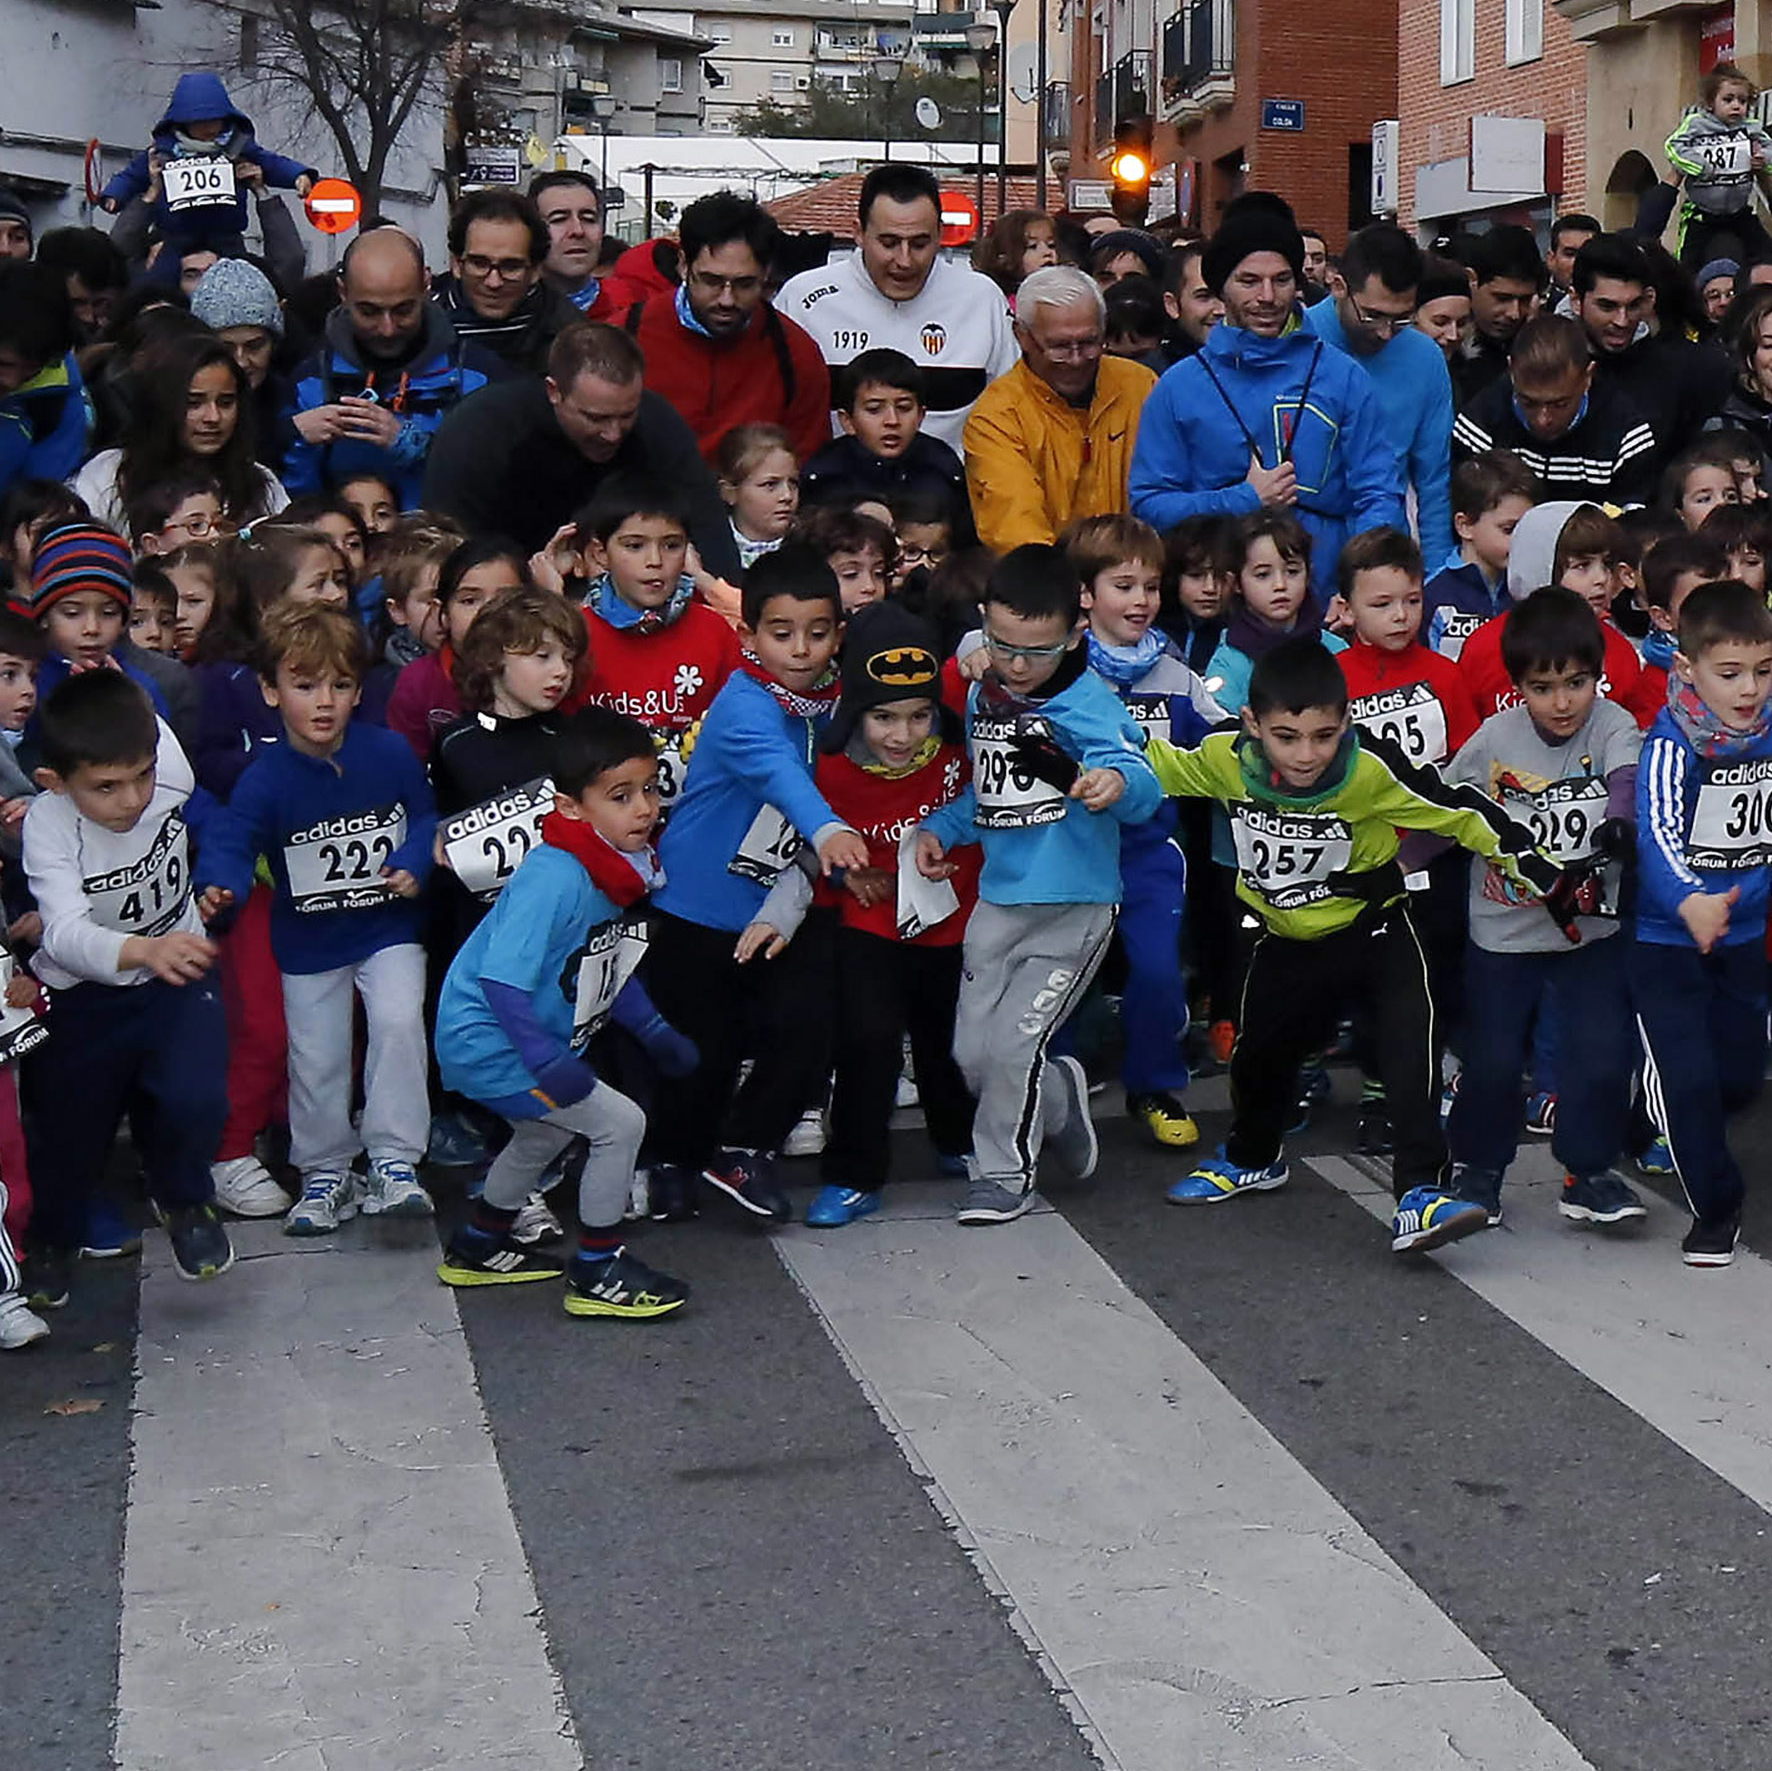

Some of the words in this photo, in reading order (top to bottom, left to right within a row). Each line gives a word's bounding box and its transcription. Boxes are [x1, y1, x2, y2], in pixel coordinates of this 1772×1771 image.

[180, 169, 221, 192] 206
[832, 330, 869, 350] 1919
[1350, 692, 1407, 719] didas
[290, 814, 379, 844] adidas
[447, 792, 532, 840] adidas
[1236, 806, 1313, 839] adidas
[1529, 808, 1588, 852] 229
[88, 841, 166, 892] adidas
[319, 834, 395, 882] 222
[1252, 839, 1325, 880] 257
[118, 855, 181, 923] 419
[9, 1026, 50, 1058] FORUM
